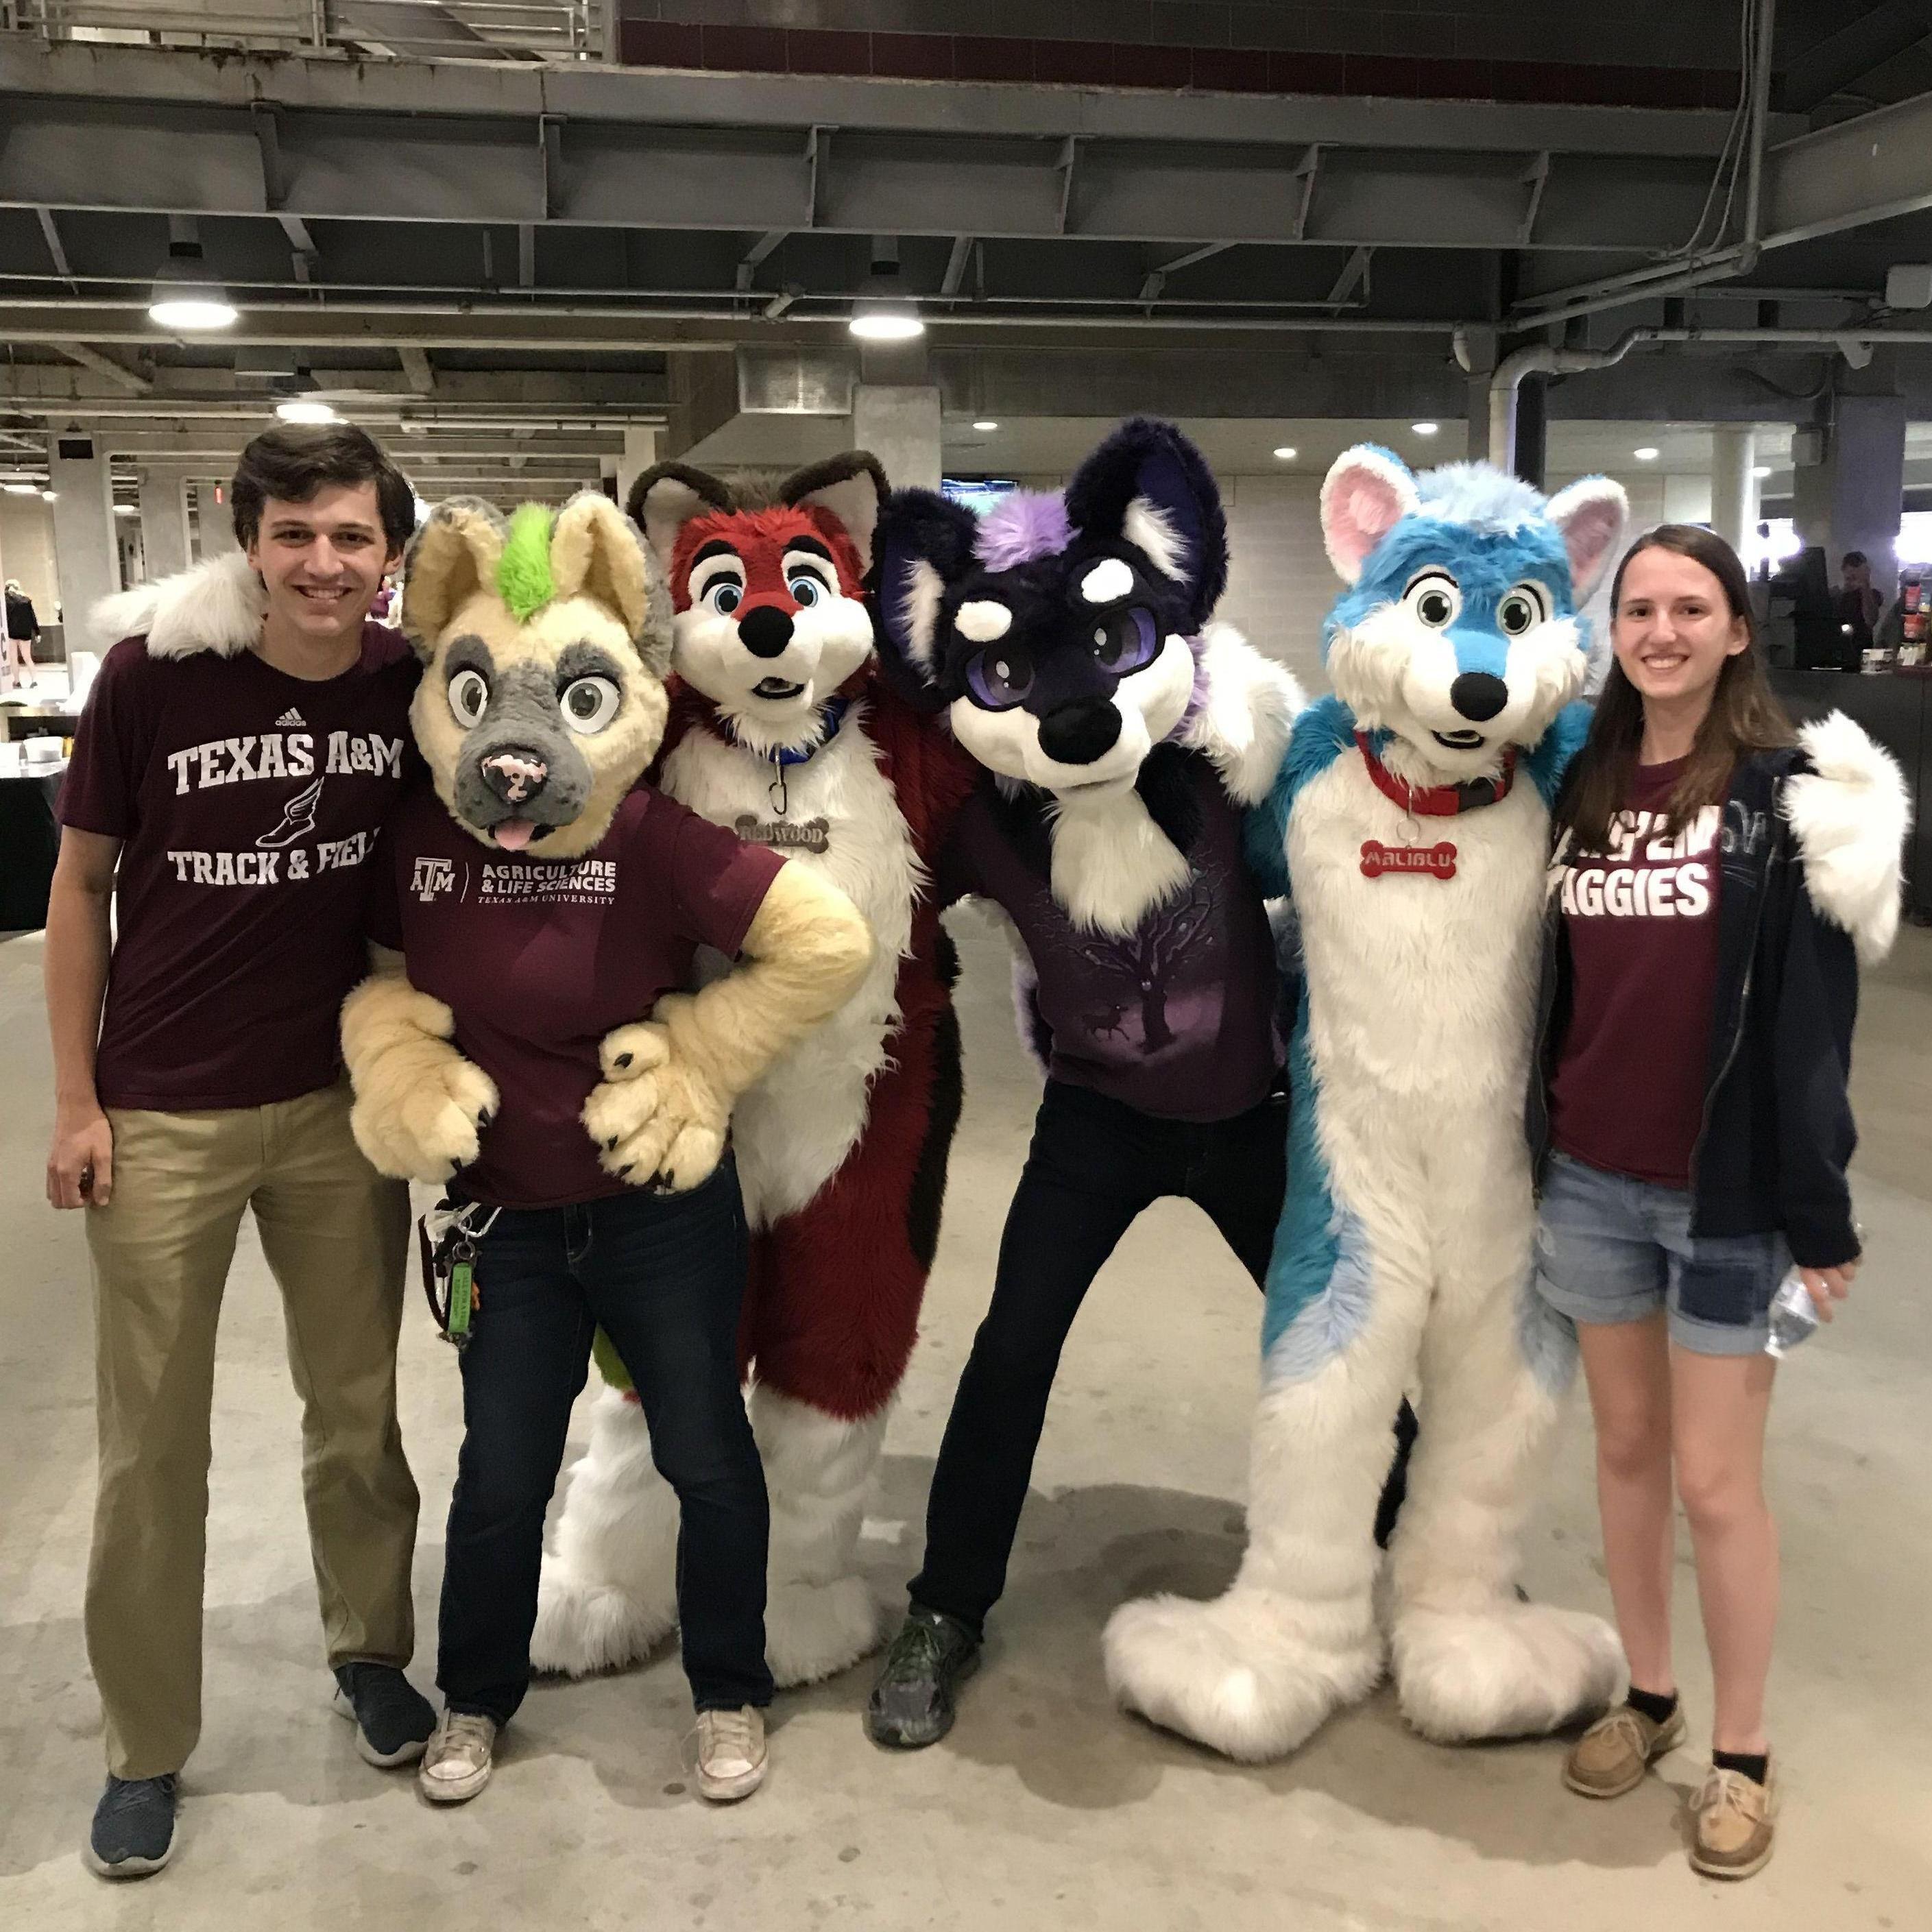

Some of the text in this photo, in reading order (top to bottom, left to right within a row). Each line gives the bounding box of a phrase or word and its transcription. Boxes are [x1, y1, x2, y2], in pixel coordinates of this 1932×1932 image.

[167, 731, 404, 795] TEXAS A&M
[167, 851, 280, 886] TRACK
[287, 849, 309, 880] &
[482, 860, 616, 880] AGRICULTURE
[481, 876, 616, 894] & LIFE SCIENCES
[1560, 862, 1711, 917] AGGIES
[478, 894, 615, 905] TEXAS A&M UNIVERSITY
